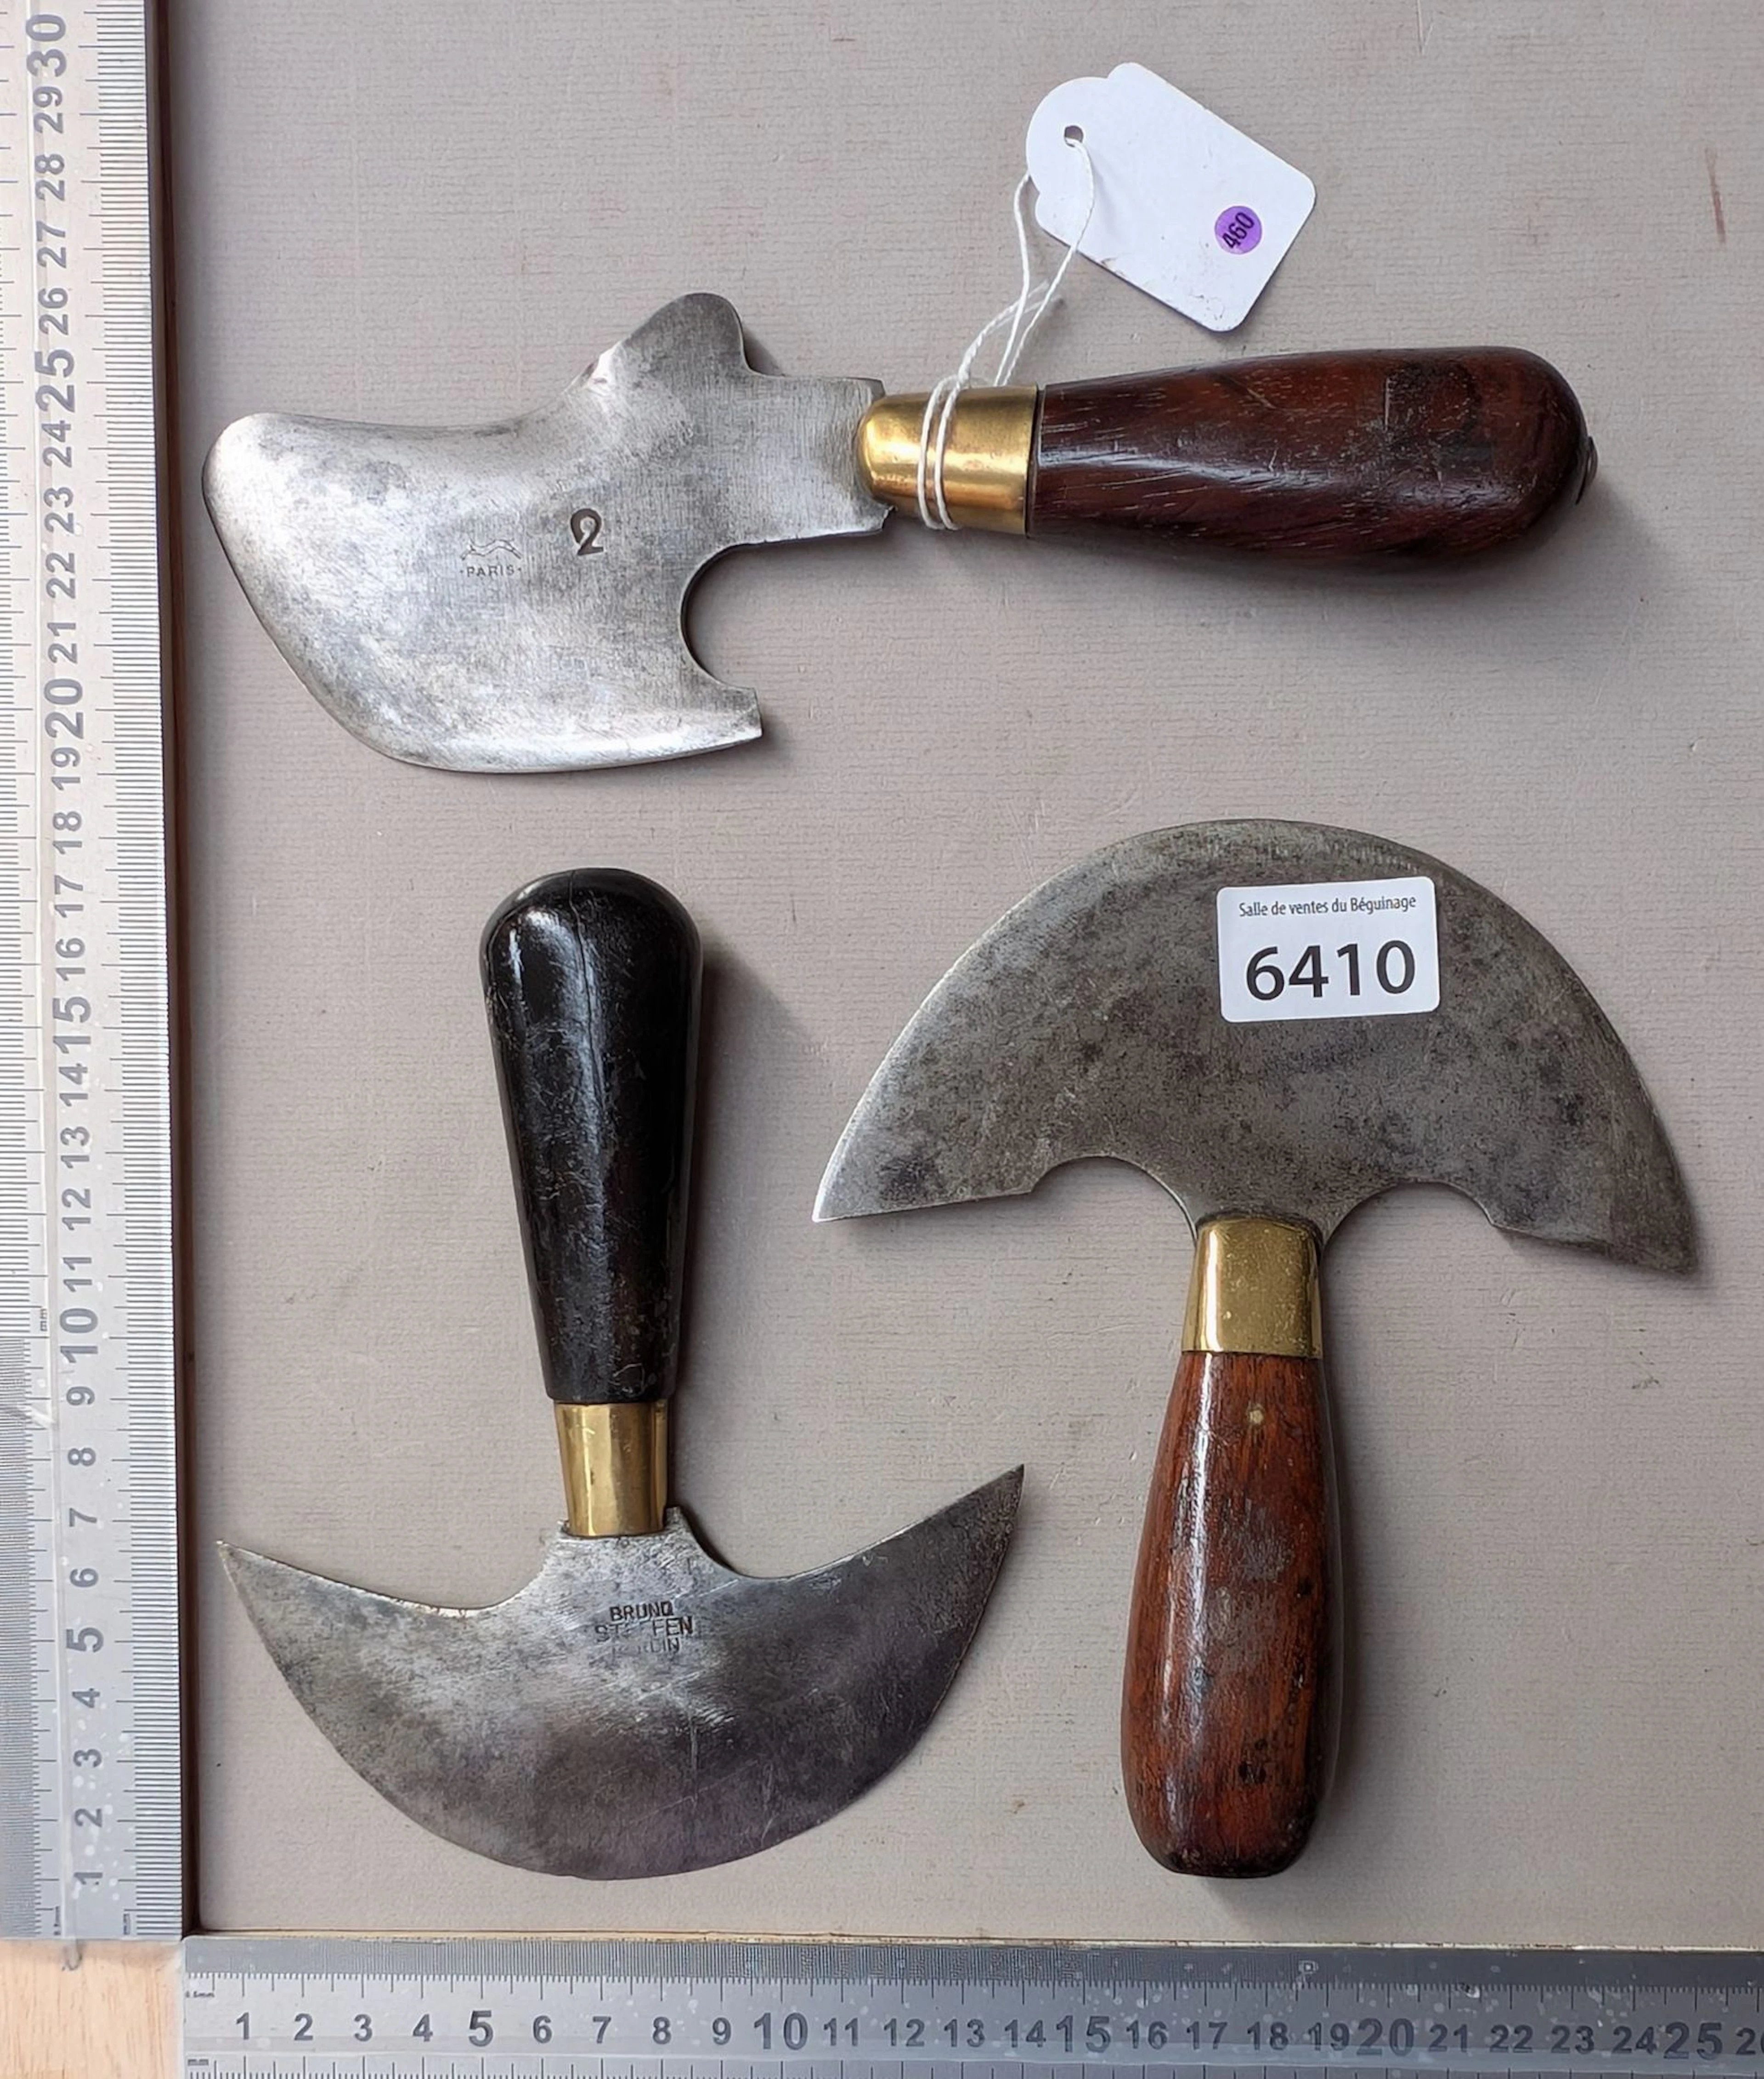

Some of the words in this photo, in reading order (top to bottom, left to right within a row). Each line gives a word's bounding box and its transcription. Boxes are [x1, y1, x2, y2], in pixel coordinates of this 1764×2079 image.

[26, 14, 67, 77] 30
[33, 86, 63, 134] 29
[35, 154, 65, 201] 28
[36, 220, 67, 268] 27
[1222, 212, 1255, 248] 460
[38, 288, 68, 335] 26
[34, 349, 75, 412] 25
[41, 420, 72, 468] 24
[43, 487, 74, 534] 23
[570, 508, 604, 556] 2
[45, 553, 76, 599] 22
[47, 622, 77, 664] 21
[44, 678, 84, 739] 20
[51, 746, 80, 791] 19
[52, 811, 83, 854] 18
[54, 875, 84, 918] 17
[1239, 902, 1268, 917] Salle
[1271, 901, 1286, 915] de
[1289, 900, 1328, 914] ventes
[1332, 898, 1347, 913] du
[1351, 896, 1416, 914] Béguinage
[55, 938, 86, 981] 16
[1246, 940, 1415, 1001] 6410
[52, 996, 91, 1054] 15
[59, 1063, 88, 1107] 14
[60, 1126, 90, 1169] 13
[62, 1188, 91, 1231] 12
[62, 1257, 92, 1292] 11
[59, 1308, 98, 1363] 10
[66, 1386, 95, 1406] 9
[68, 1447, 96, 1466] 8
[69, 1508, 97, 1527] 7
[70, 1568, 98, 1587] 6
[609, 1601, 674, 1621] BRUNO
[66, 1627, 104, 1653] 5
[72, 1688, 100, 1708] 4
[73, 1749, 102, 1768] 3
[74, 1808, 103, 1827] 2
[74, 1872, 103, 1885] 1
[237, 2012, 249, 2040] 1
[294, 2013, 313, 2041] 2
[354, 2014, 373, 2041] 3
[413, 2014, 433, 2042] 4
[469, 2010, 493, 2047] 5
[532, 2016, 552, 2044] 6
[592, 2017, 611, 2044] 7
[653, 2017, 671, 2045] 8
[712, 2017, 731, 2045] 9
[753, 2012, 808, 2050] 10
[823, 2018, 858, 2046] 11
[883, 2018, 925, 2047] 12
[944, 2019, 985, 2047] 13
[1004, 2019, 1046, 2048] 14
[1056, 2015, 1111, 2053] 15
[1126, 2021, 1168, 2050] 16
[1186, 2022, 1227, 2050] 17
[1247, 2022, 1289, 2051] 18
[1308, 2023, 1349, 2051] 19
[1356, 2018, 1414, 2056] 20
[1429, 2023, 1468, 2052] 21
[1489, 2024, 1533, 2053] 22
[1550, 2025, 1594, 2054] 23
[1612, 2026, 1657, 2055] 24
[1663, 2022, 1722, 2060] 25
[1736, 2027, 1764, 2056] 2
